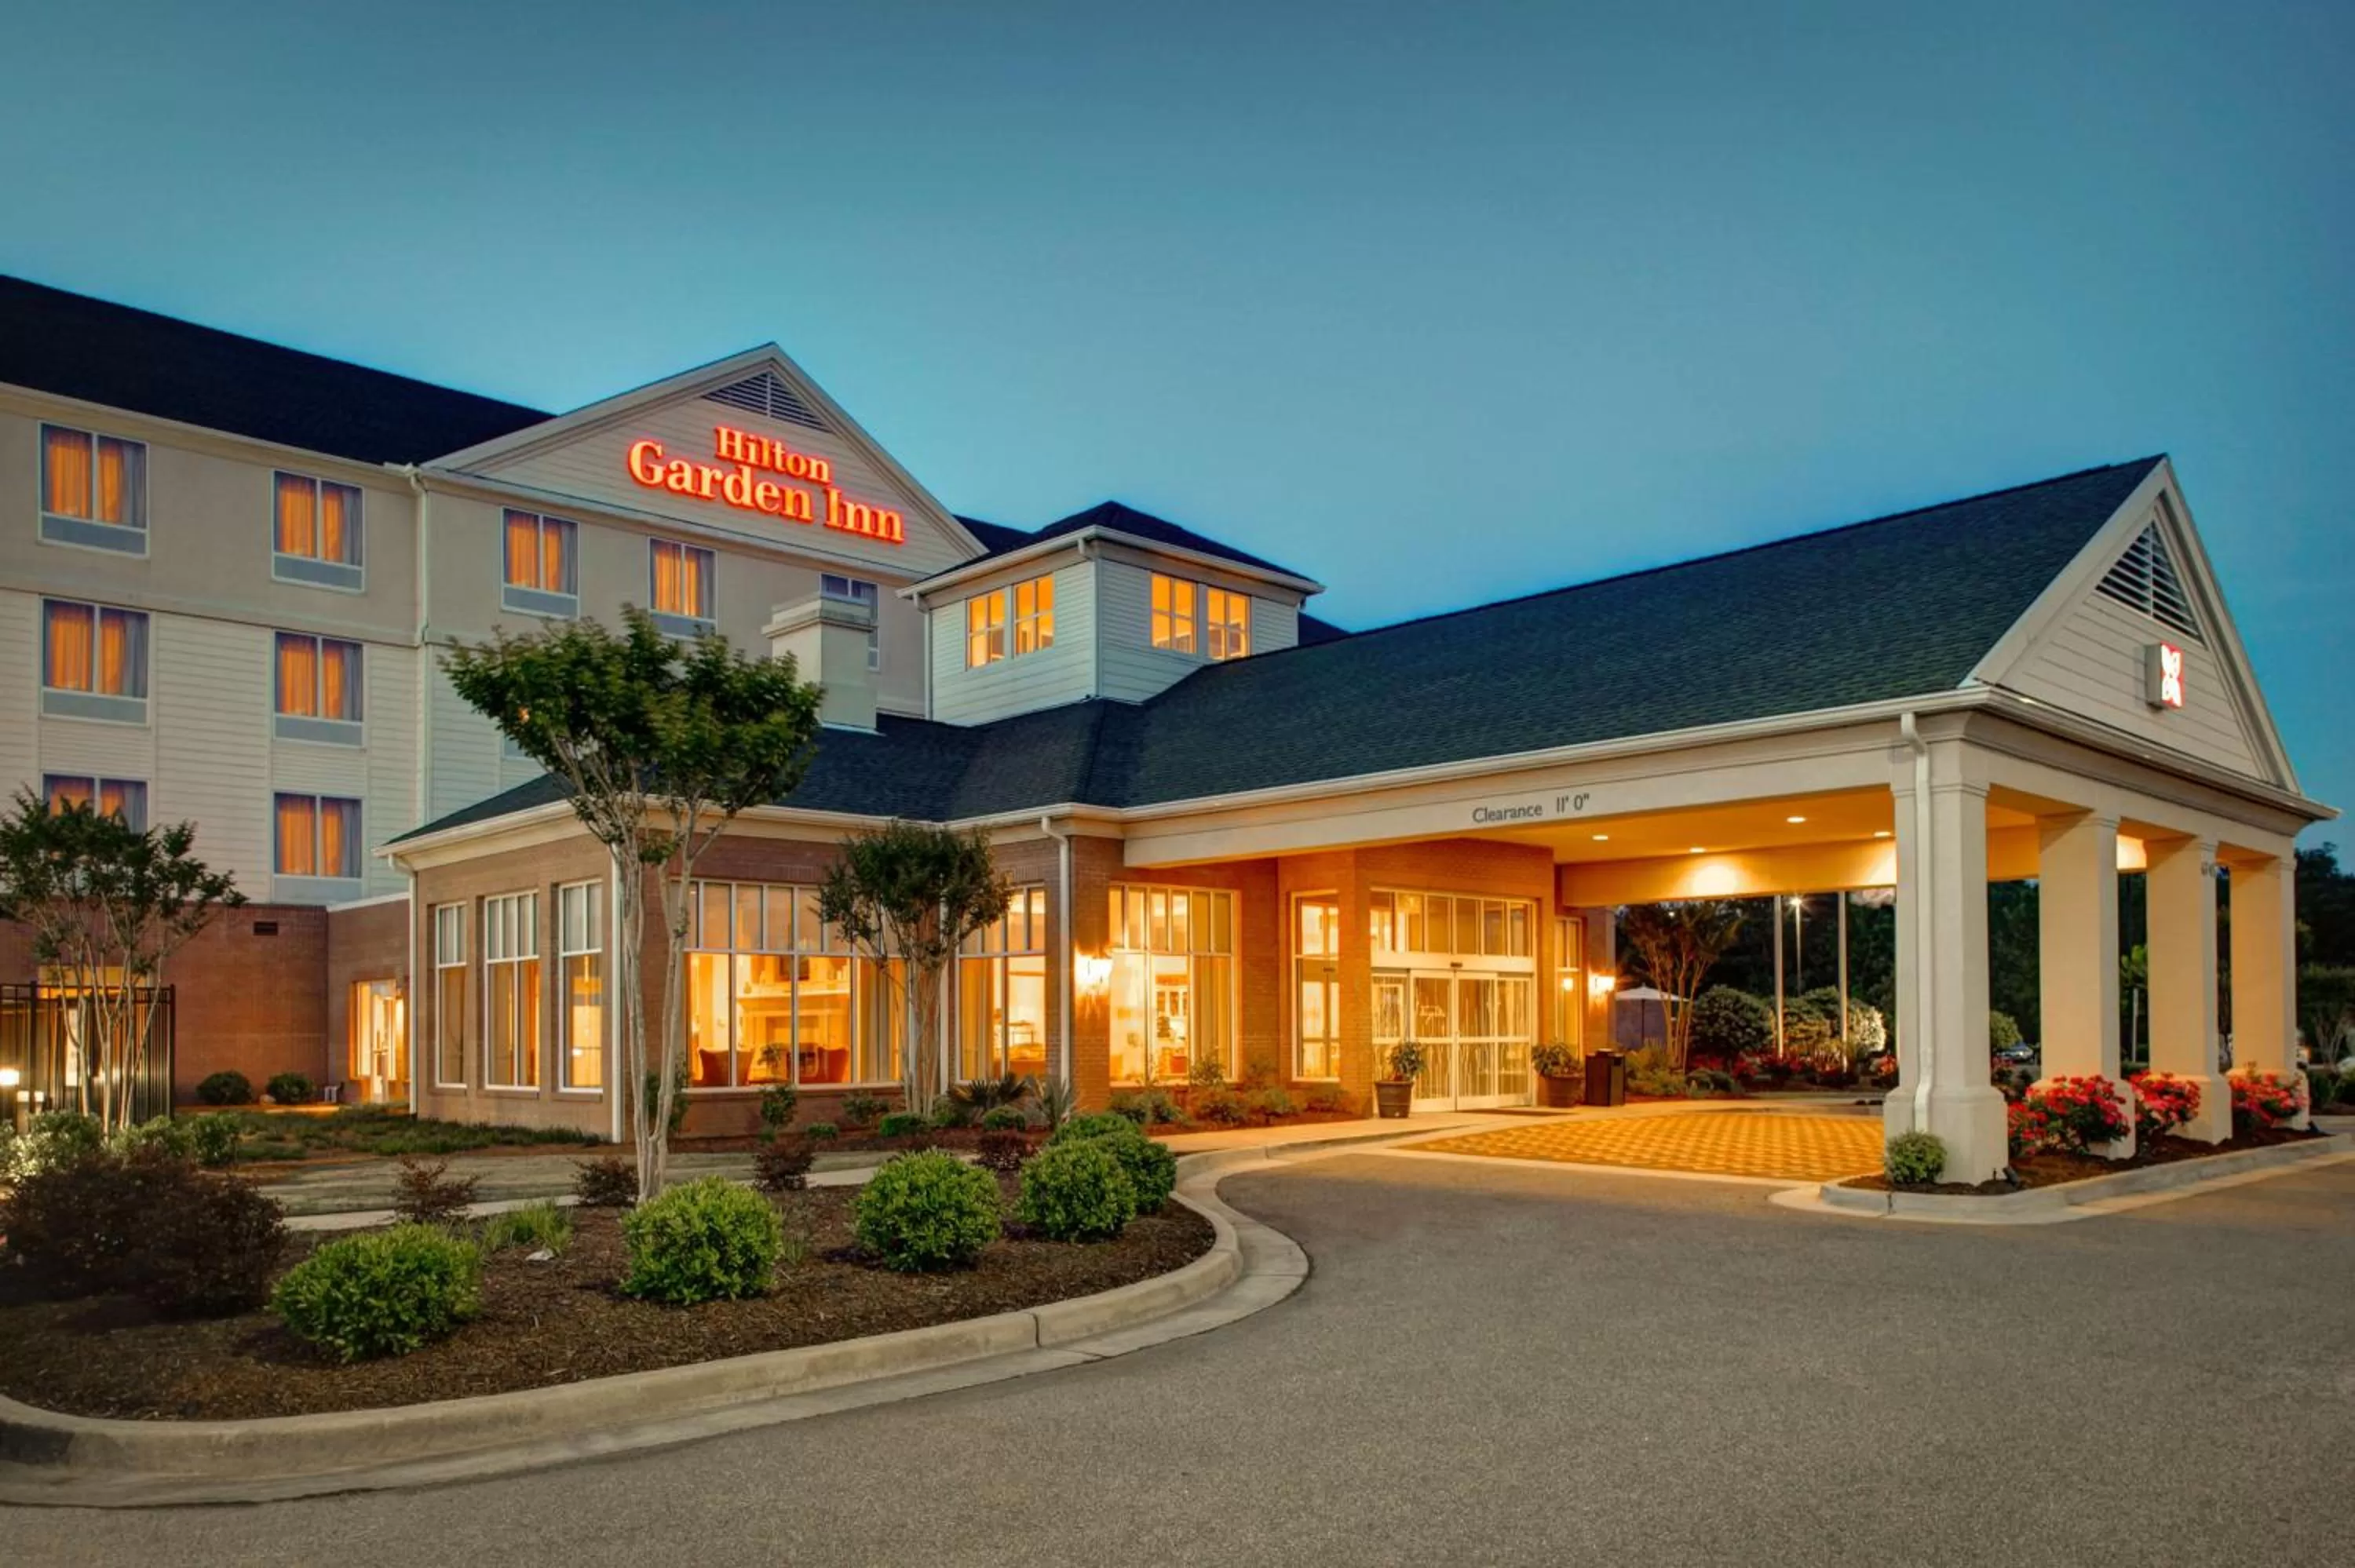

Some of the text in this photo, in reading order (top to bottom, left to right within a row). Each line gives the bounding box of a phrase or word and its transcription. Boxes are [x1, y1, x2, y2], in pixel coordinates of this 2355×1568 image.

[715, 426, 831, 483] Hilton
[629, 440, 904, 544] Garden Inn
[1472, 804, 1543, 823] Clearance
